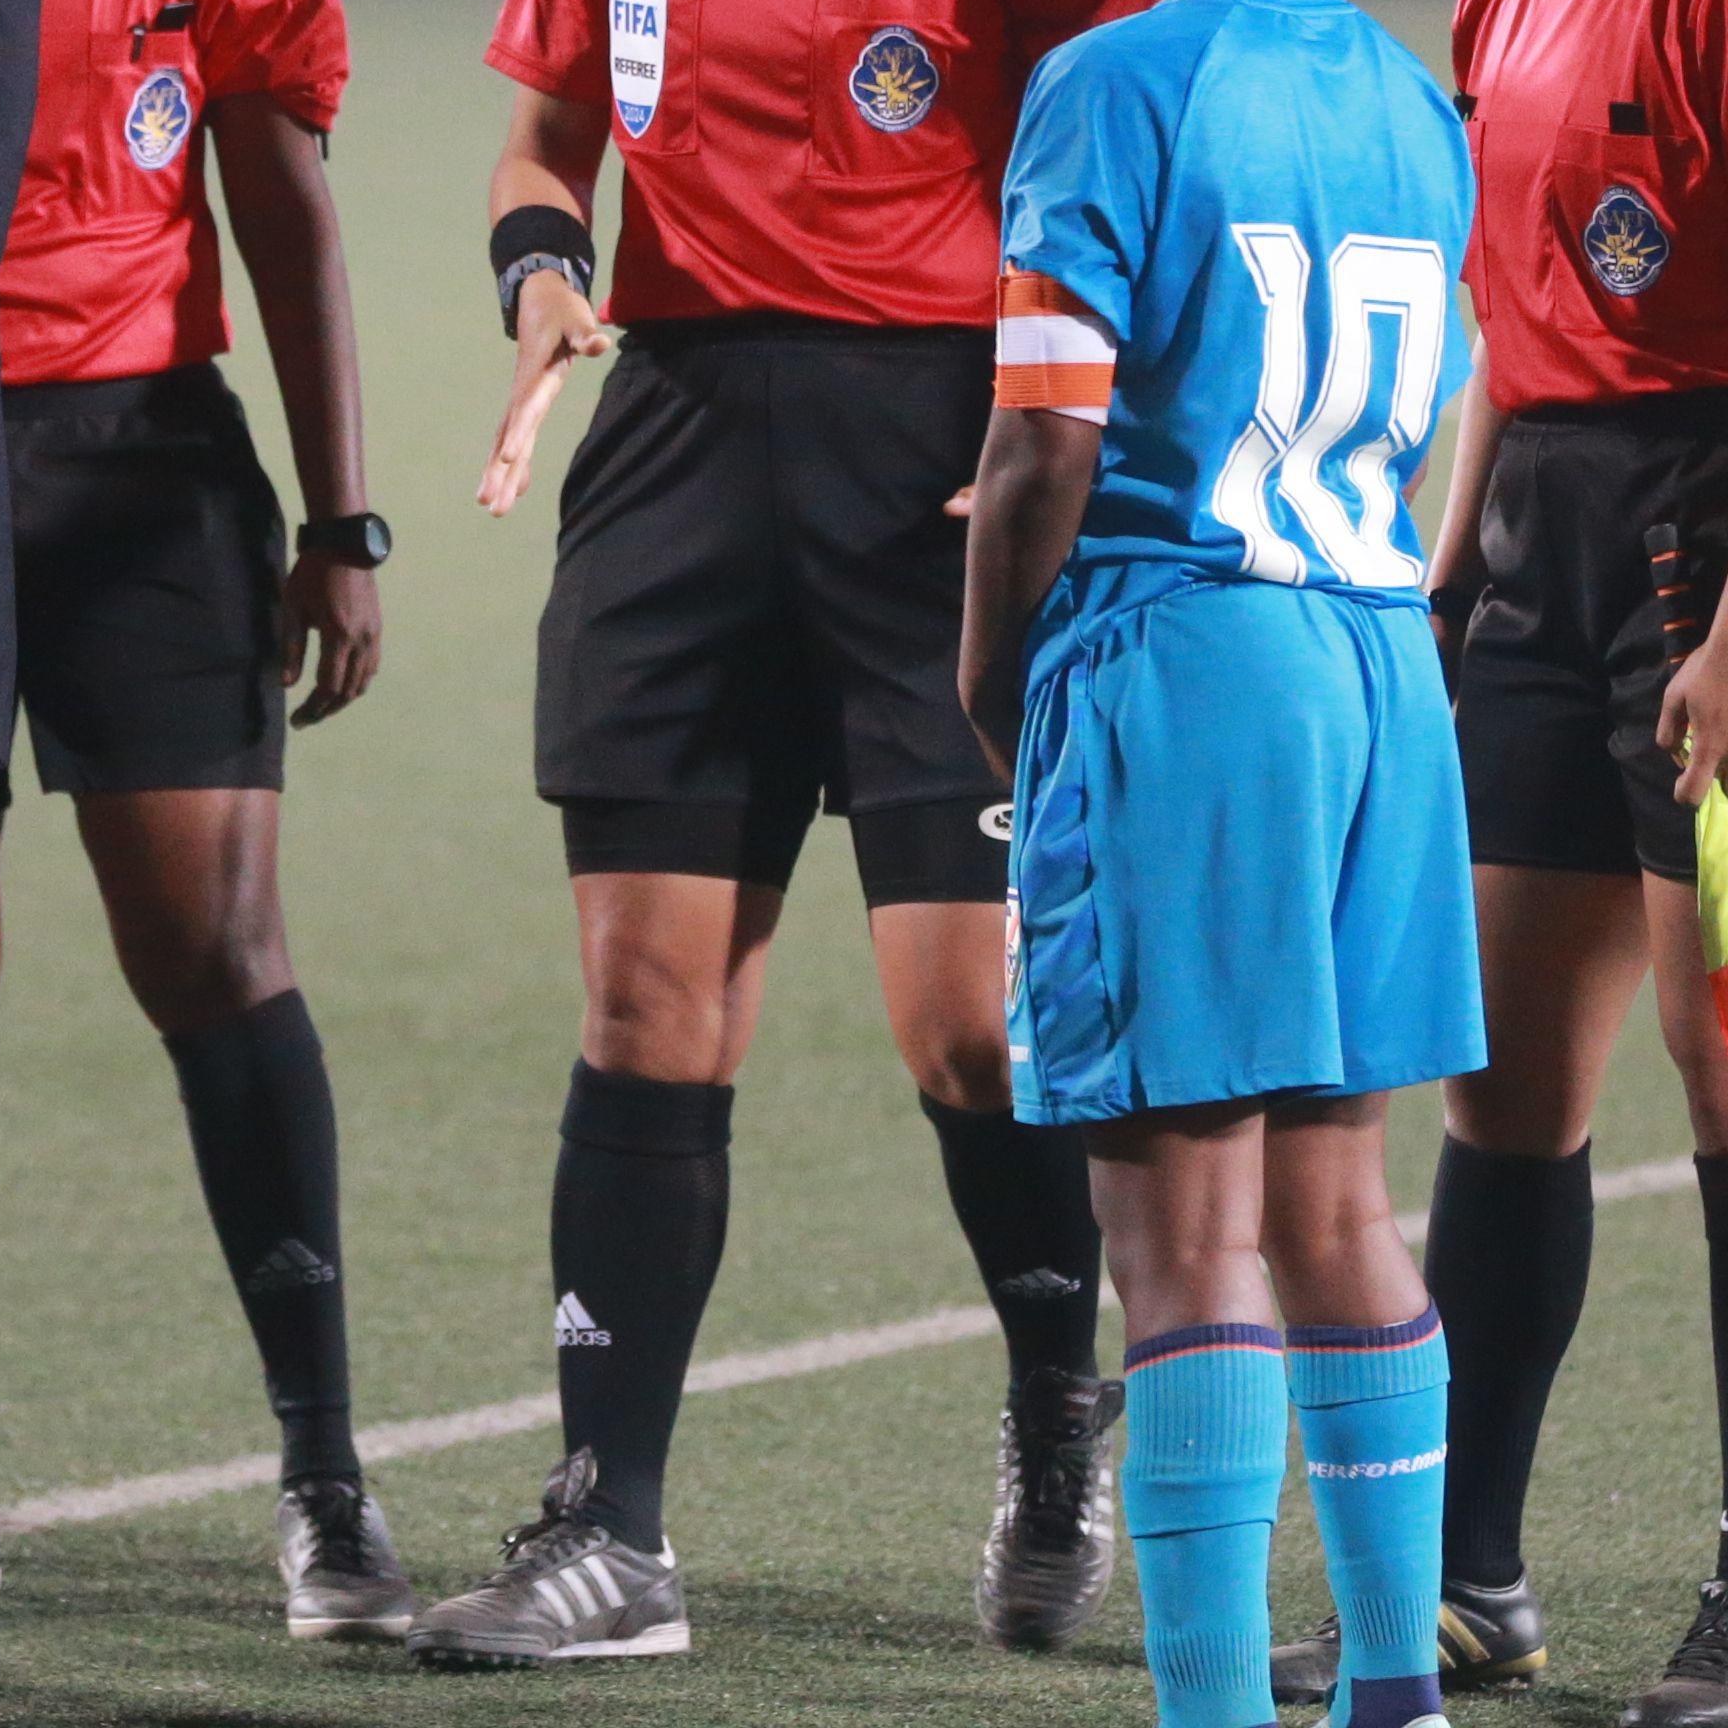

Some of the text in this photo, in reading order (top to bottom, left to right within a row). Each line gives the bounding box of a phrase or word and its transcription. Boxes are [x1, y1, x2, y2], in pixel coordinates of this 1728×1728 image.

[614, 0, 658, 39] FIFA
[614, 57, 657, 80] REFEREE
[1212, 223, 1446, 588] 10
